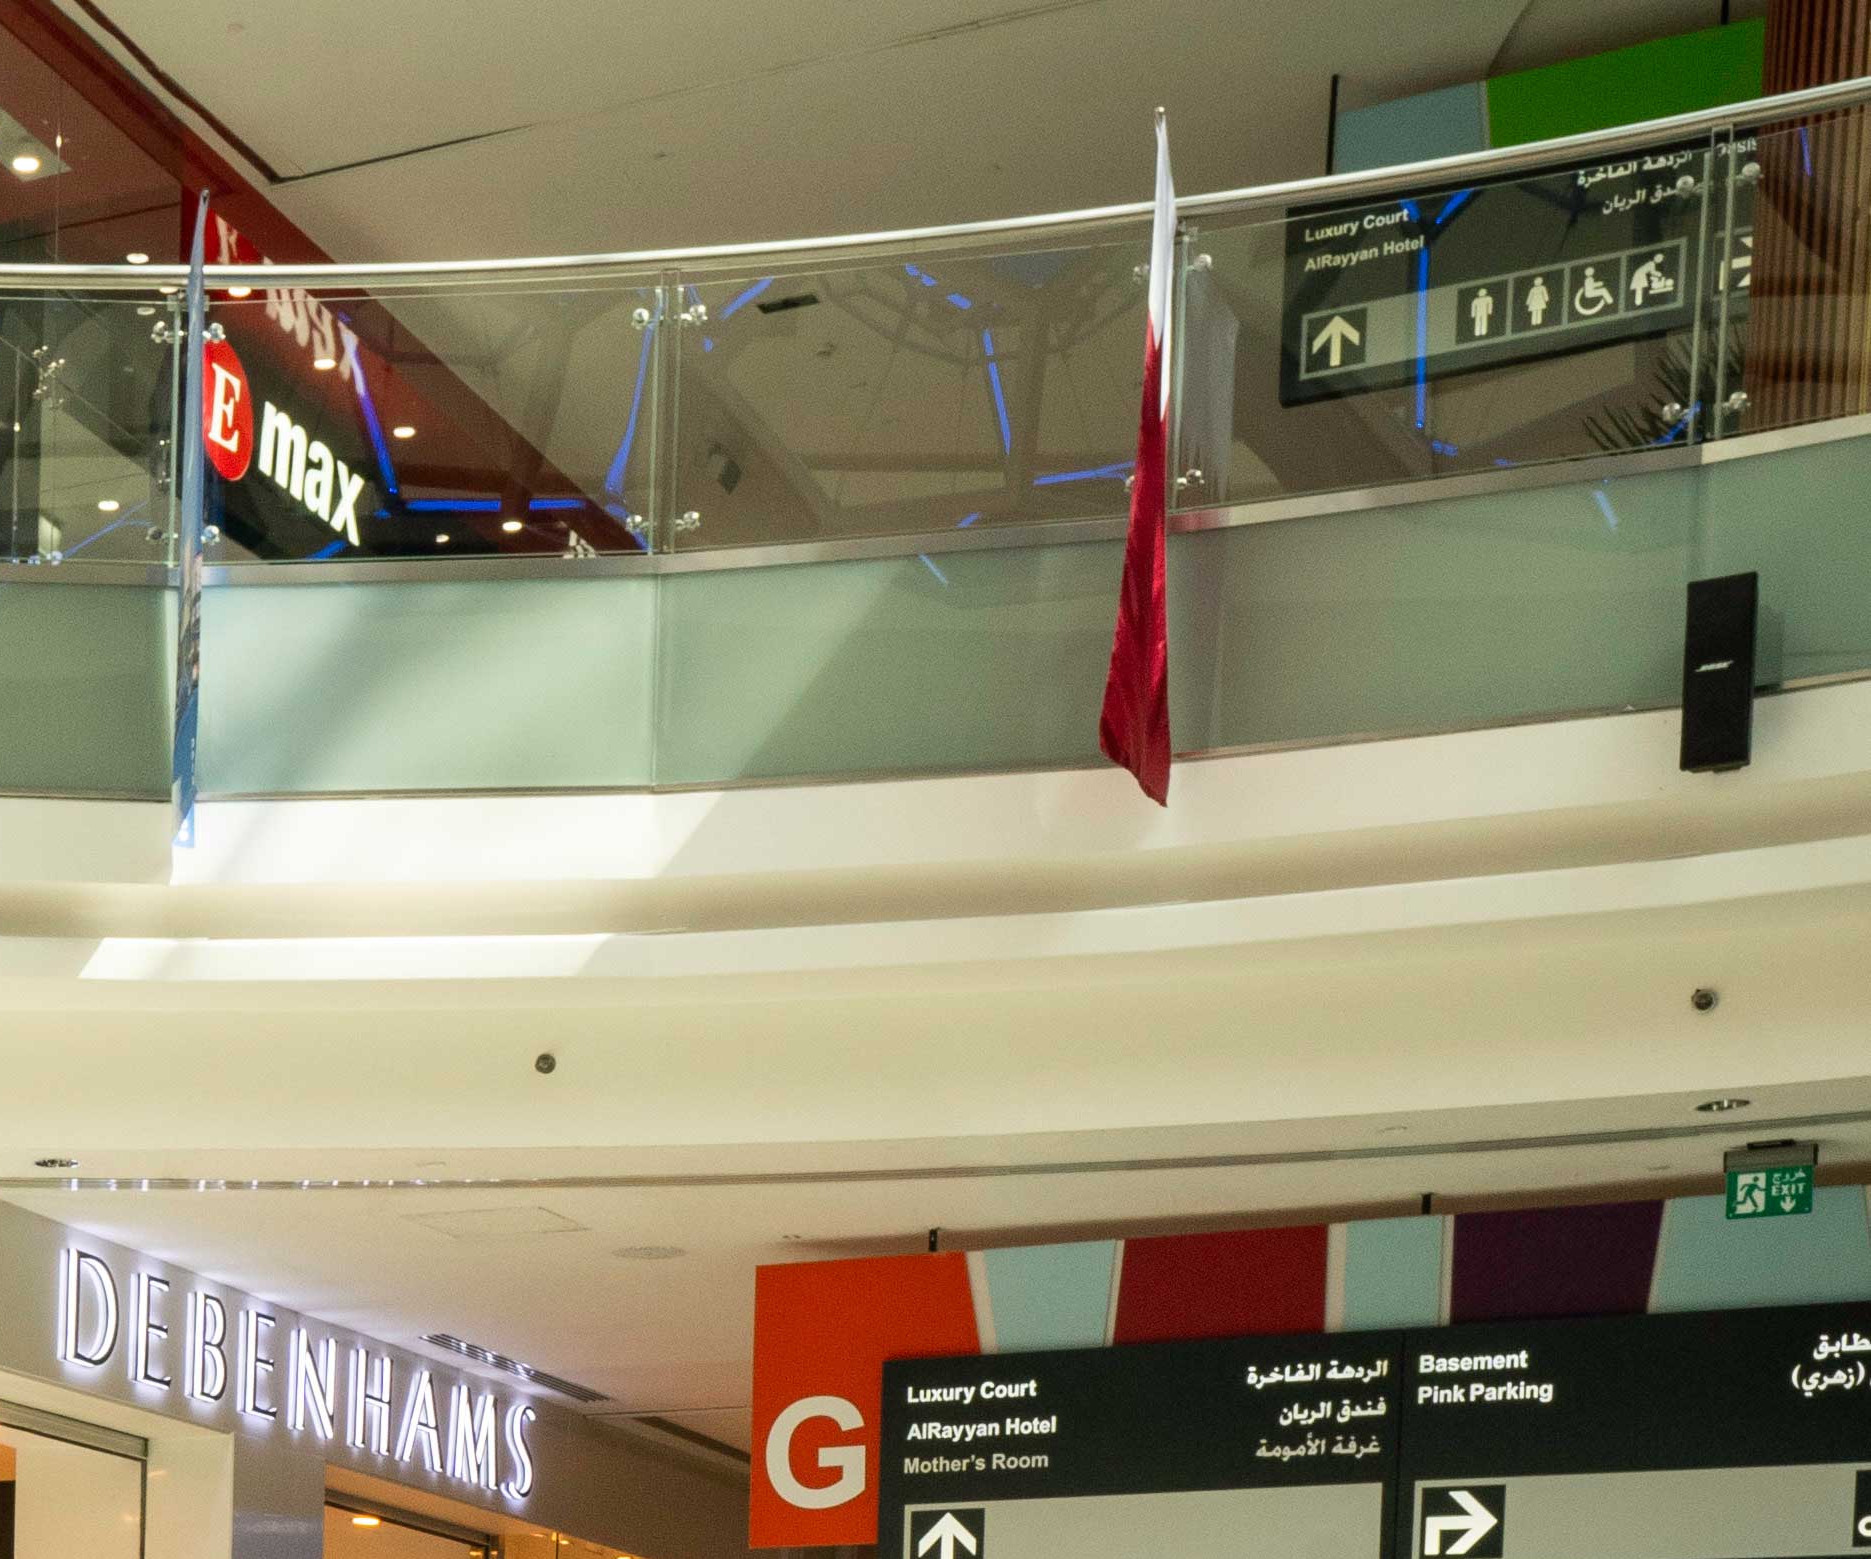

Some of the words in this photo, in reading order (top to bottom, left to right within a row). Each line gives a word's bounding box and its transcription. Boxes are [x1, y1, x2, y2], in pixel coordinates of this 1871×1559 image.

[1602, 189, 1646, 215] الريان
[1305, 221, 1359, 242] Luxury
[1363, 208, 1410, 229] Court
[1304, 246, 1379, 272] AlRayyan
[1383, 234, 1425, 256] Hotel
[1771, 1183, 1806, 1196] EXIT
[59, 1247, 537, 1501] DEBENHAMS
[1326, 1360, 1389, 1383] الردهة
[1419, 1350, 1529, 1373] Basement
[1247, 1363, 1322, 1389] الفاخرة
[907, 1386, 976, 1404] Luxury
[980, 1379, 1037, 1399] Court
[1417, 1384, 1466, 1404] Pink
[1469, 1381, 1554, 1403] Parking
[1279, 1401, 1332, 1426] الريان
[1336, 1397, 1387, 1423] فندق
[906, 1421, 1000, 1442] AlRayyan
[1005, 1415, 1057, 1435] Hotel
[764, 1394, 867, 1510] G
[1255, 1432, 1326, 1462] الأمومة
[1331, 1435, 1381, 1459] غرفة
[903, 1454, 986, 1474] Mother's
[991, 1453, 1049, 1470] Room
